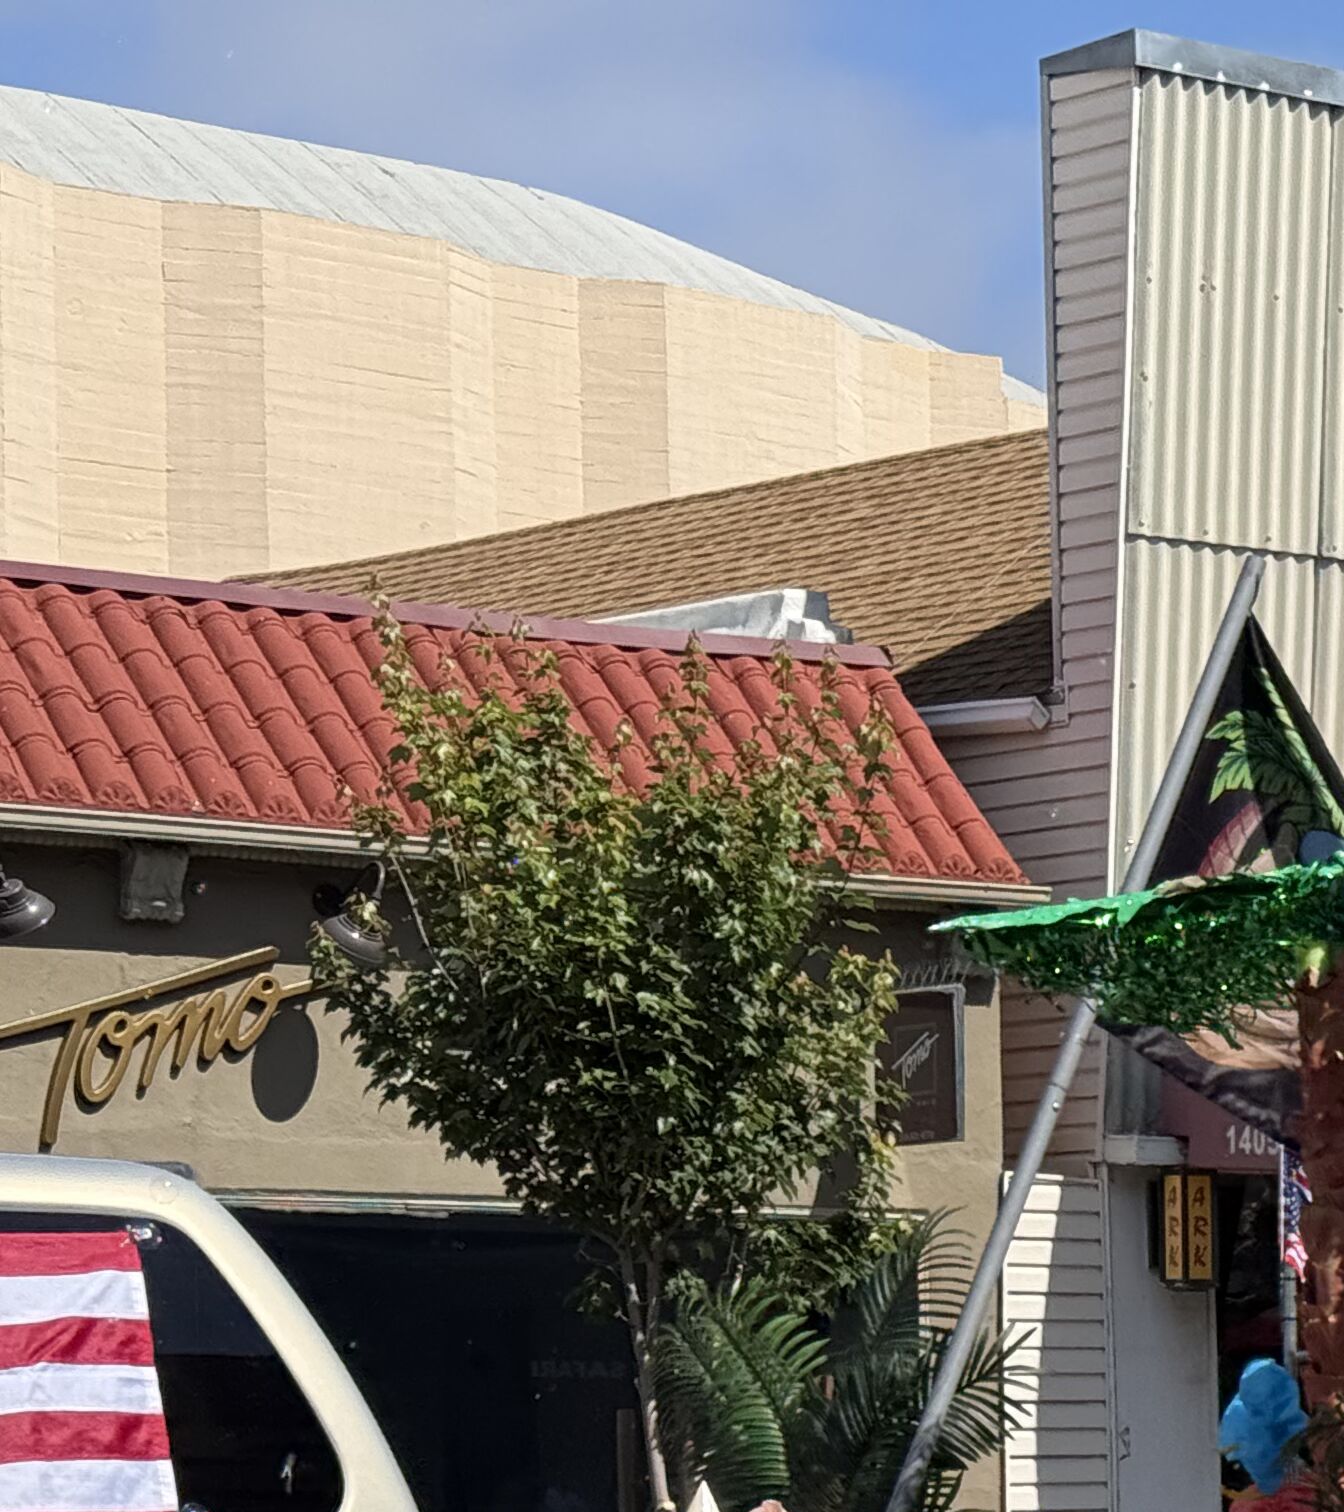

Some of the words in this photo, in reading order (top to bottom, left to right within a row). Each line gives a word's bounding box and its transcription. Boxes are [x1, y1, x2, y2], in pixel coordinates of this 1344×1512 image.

[0, 946, 320, 1146] Tomo
[889, 1032, 940, 1089] Tomo
[1166, 1184, 1180, 1268] ARK
[1190, 1185, 1209, 1268] ARK
